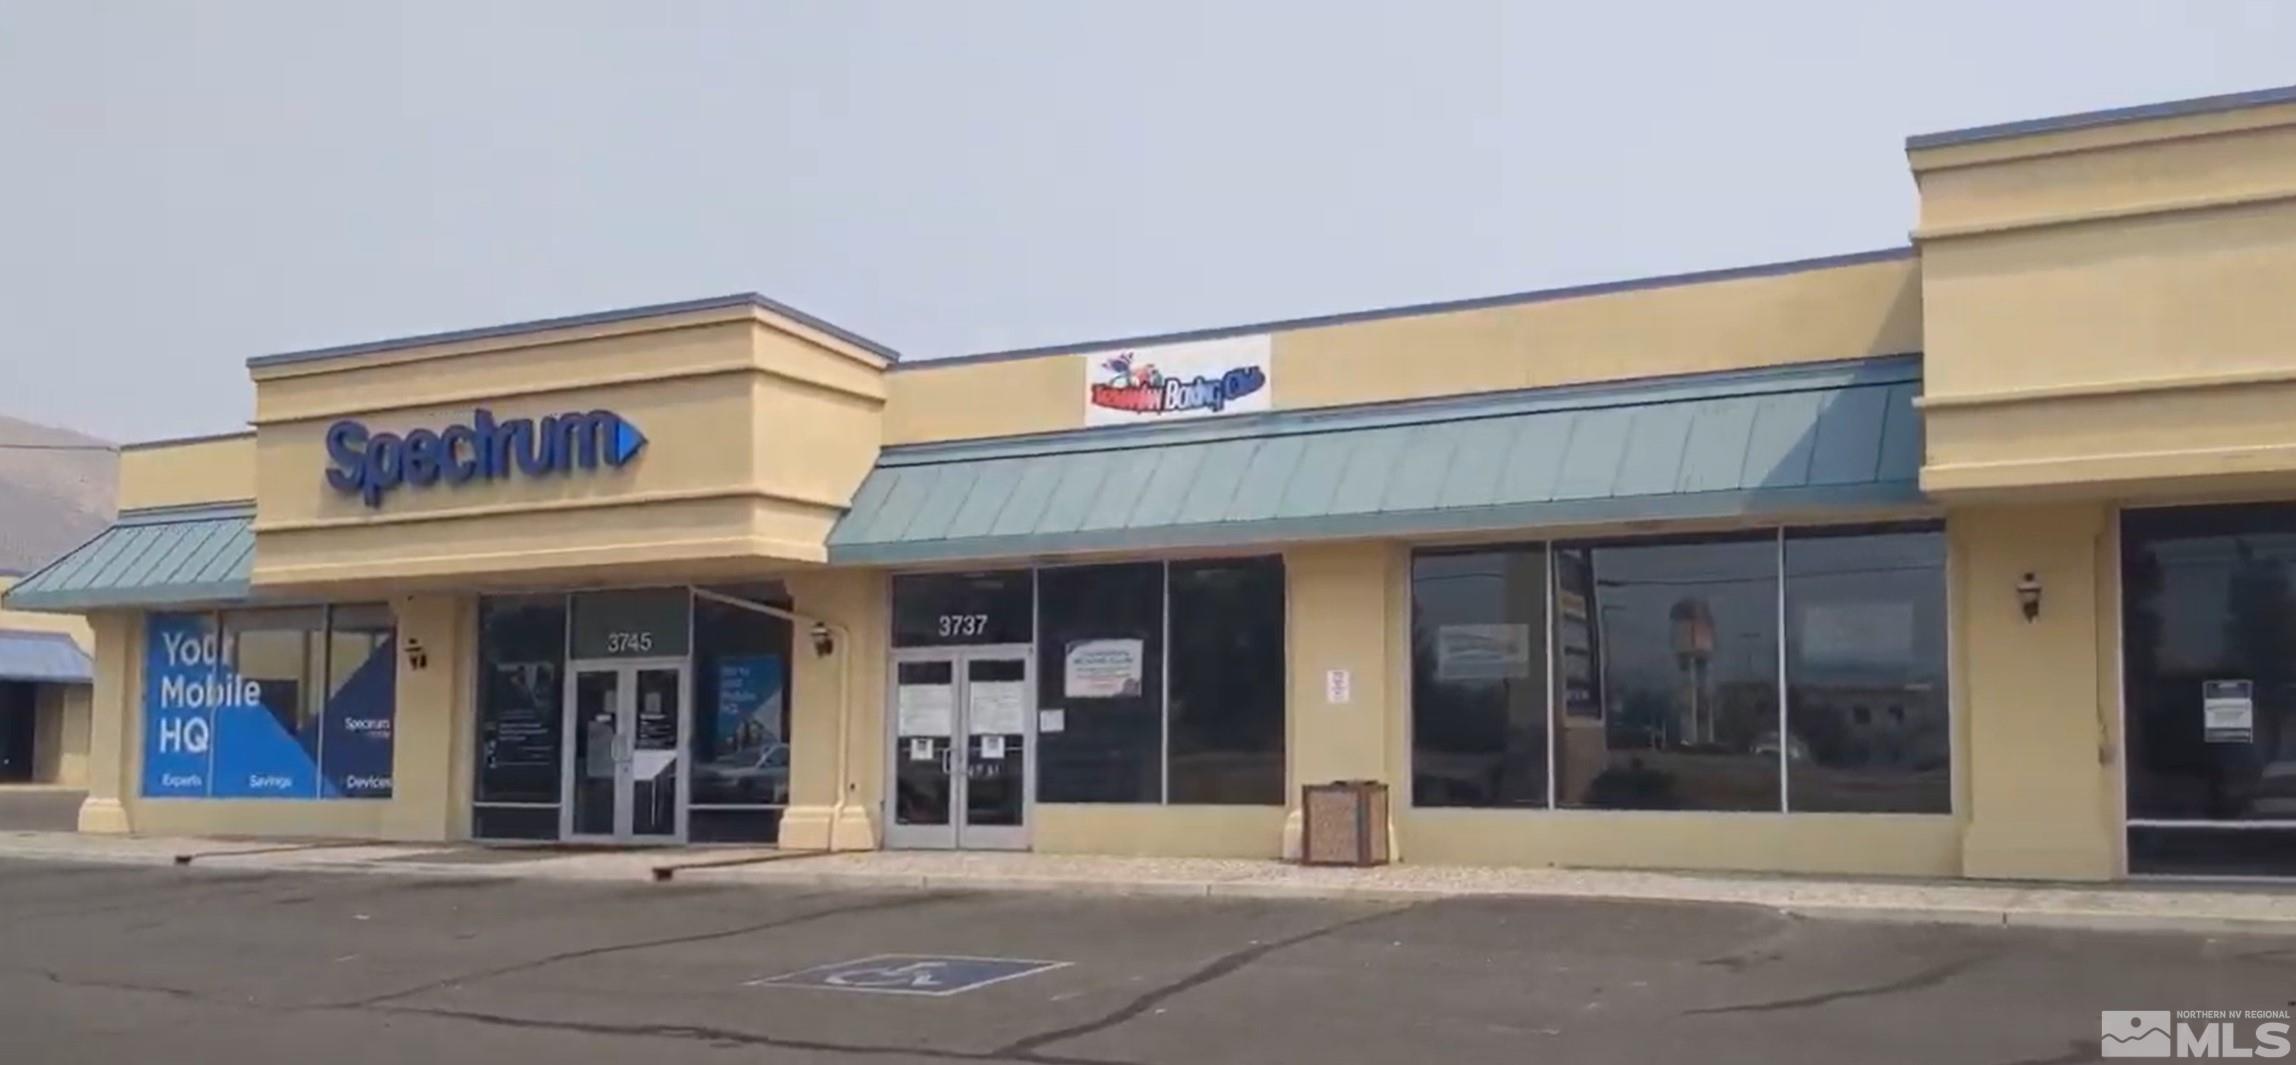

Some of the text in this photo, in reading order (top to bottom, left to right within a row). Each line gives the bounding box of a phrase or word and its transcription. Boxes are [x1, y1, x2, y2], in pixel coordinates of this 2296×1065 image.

[325, 408, 621, 508] Spectrum
[938, 615, 988, 636] 3737
[162, 631, 235, 667] Your
[608, 632, 652, 652] 3745
[161, 674, 261, 708] Mobile
[159, 717, 209, 753] HQ
[161, 774, 202, 788] Experts
[249, 774, 292, 789] Savings
